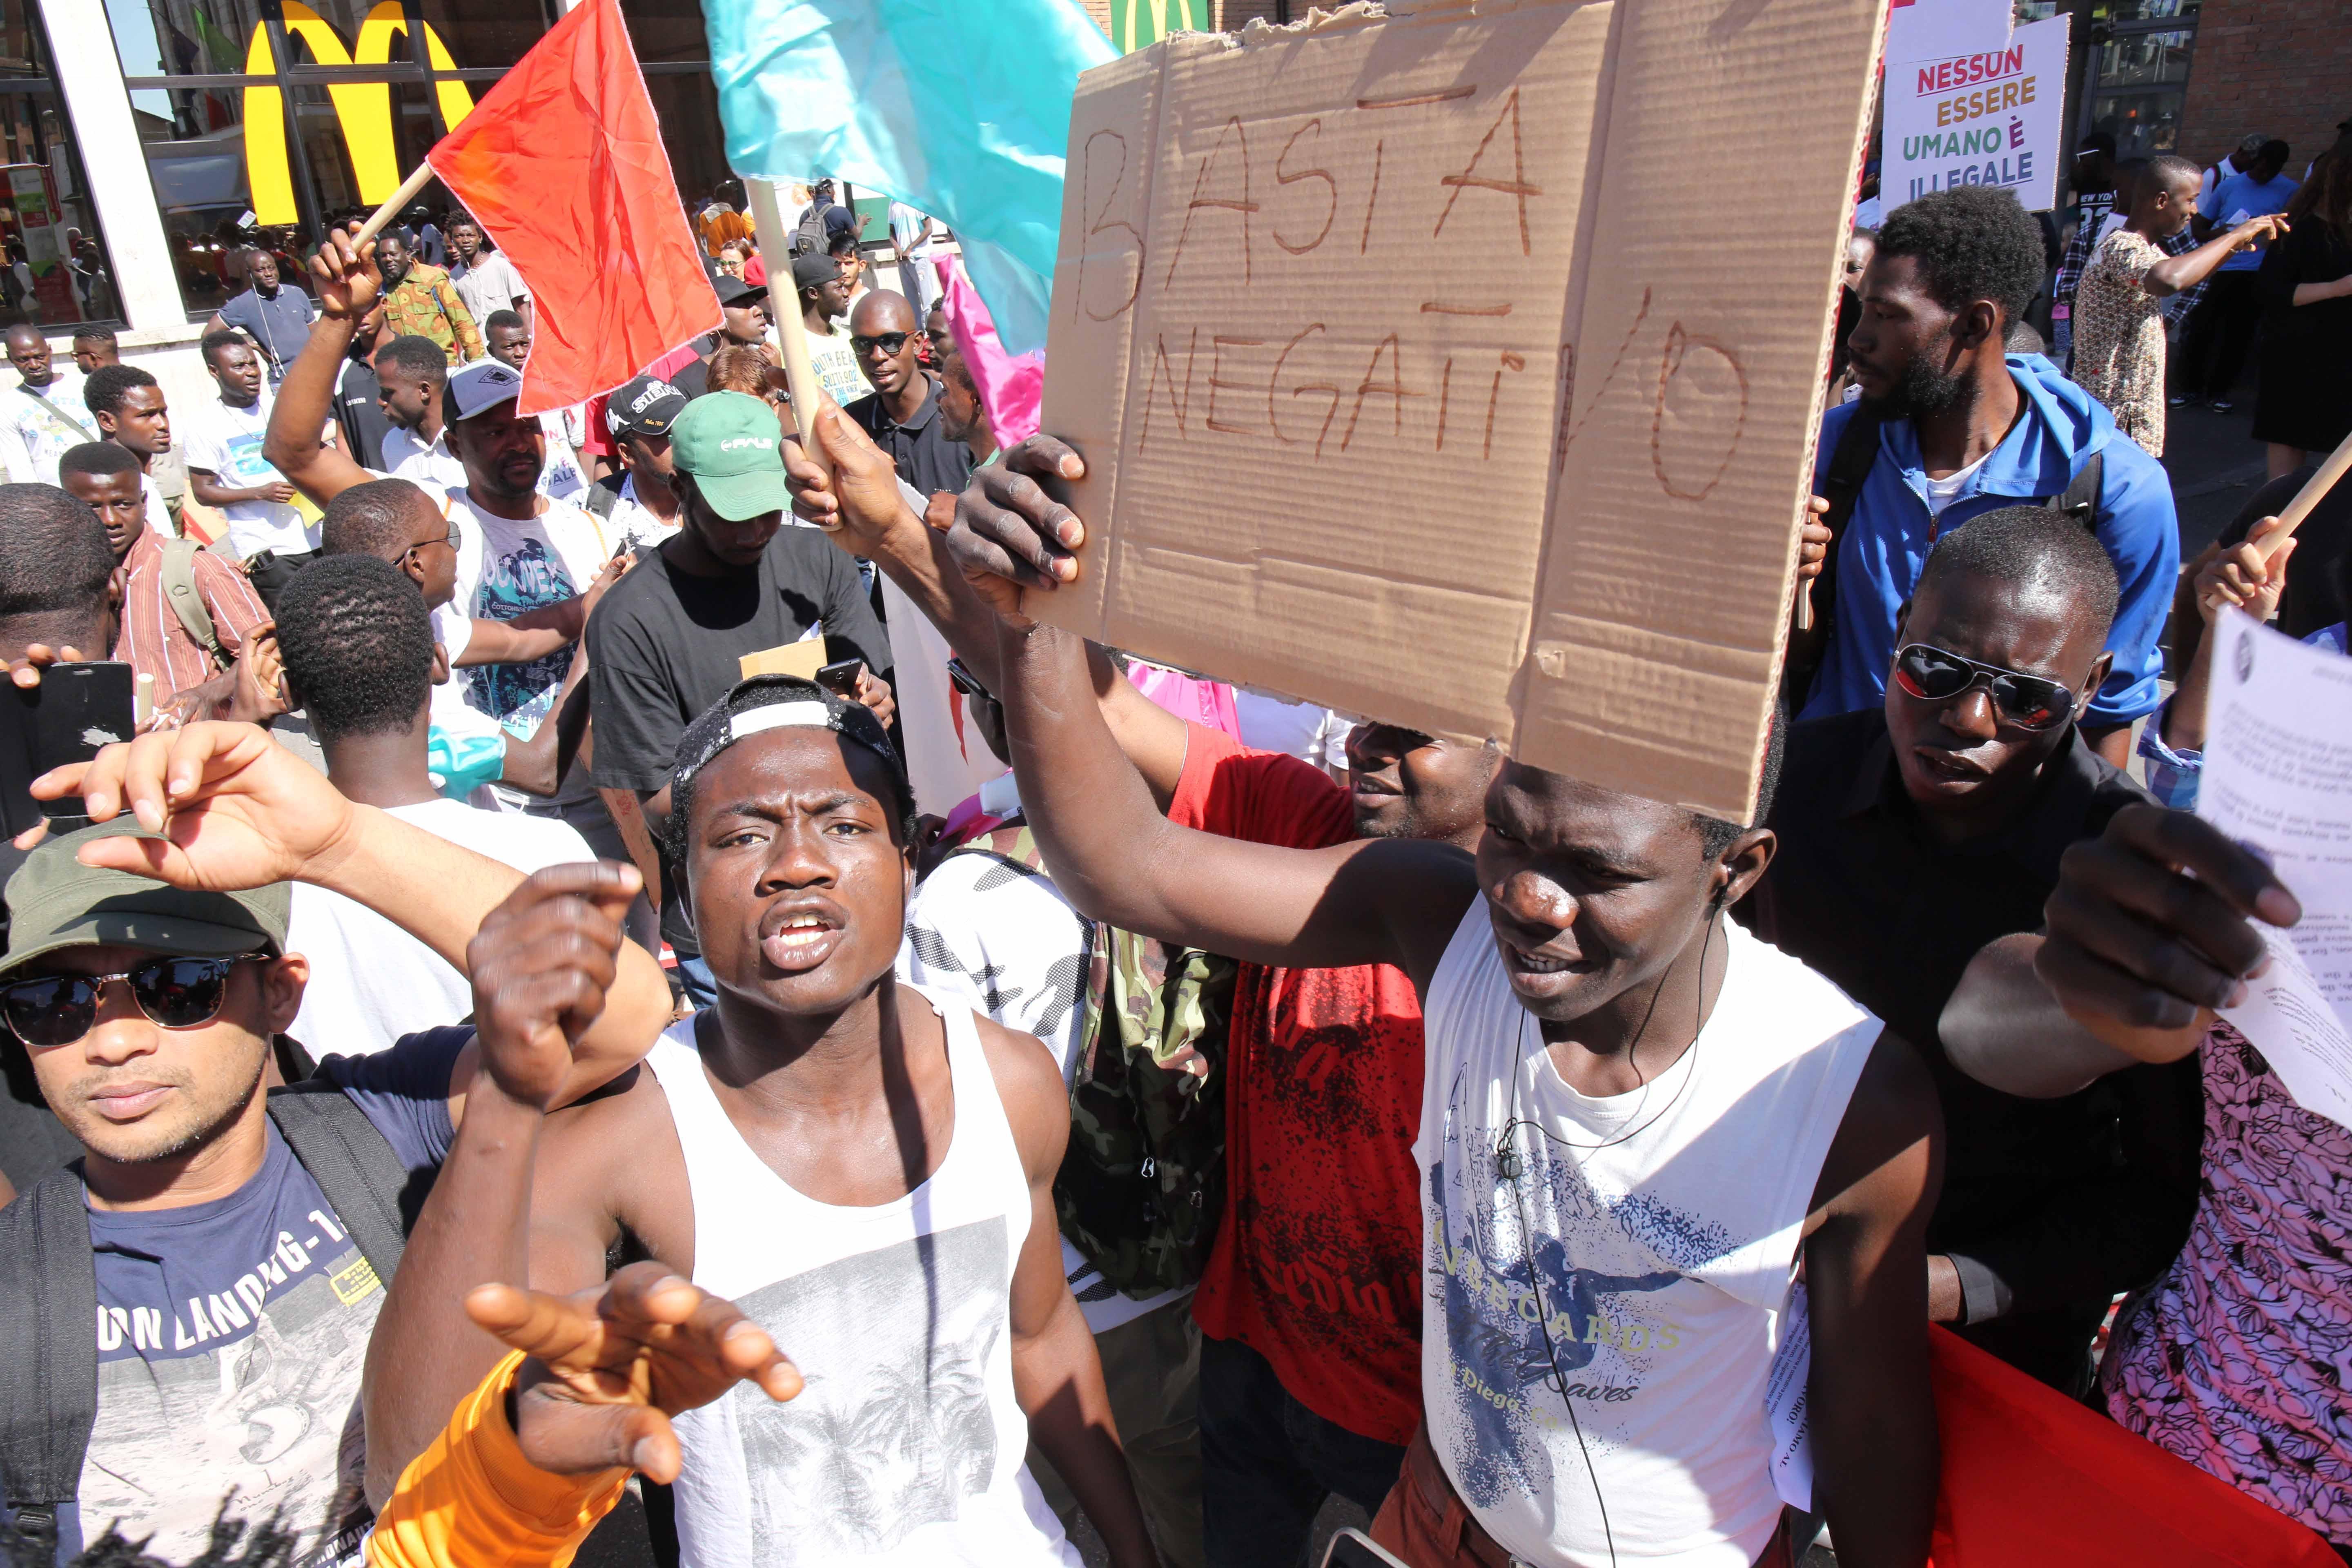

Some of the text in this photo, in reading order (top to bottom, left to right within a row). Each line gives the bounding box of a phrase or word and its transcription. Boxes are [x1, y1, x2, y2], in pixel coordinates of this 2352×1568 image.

[1917, 44, 2023, 93] NESSUN
[1937, 76, 2036, 127] ESSERE
[1903, 115, 2024, 161] UMANO È
[1074, 83, 1544, 325] BASTA
[1138, 286, 1749, 501] NEGATIVO
[541, 467, 577, 487] GALE
[1780, 1344, 1791, 1355] della
[1794, 1348, 1805, 1365] positiva
[1786, 1385, 1807, 1424] VORO!
[1780, 1418, 1808, 1467] IAMO AL
